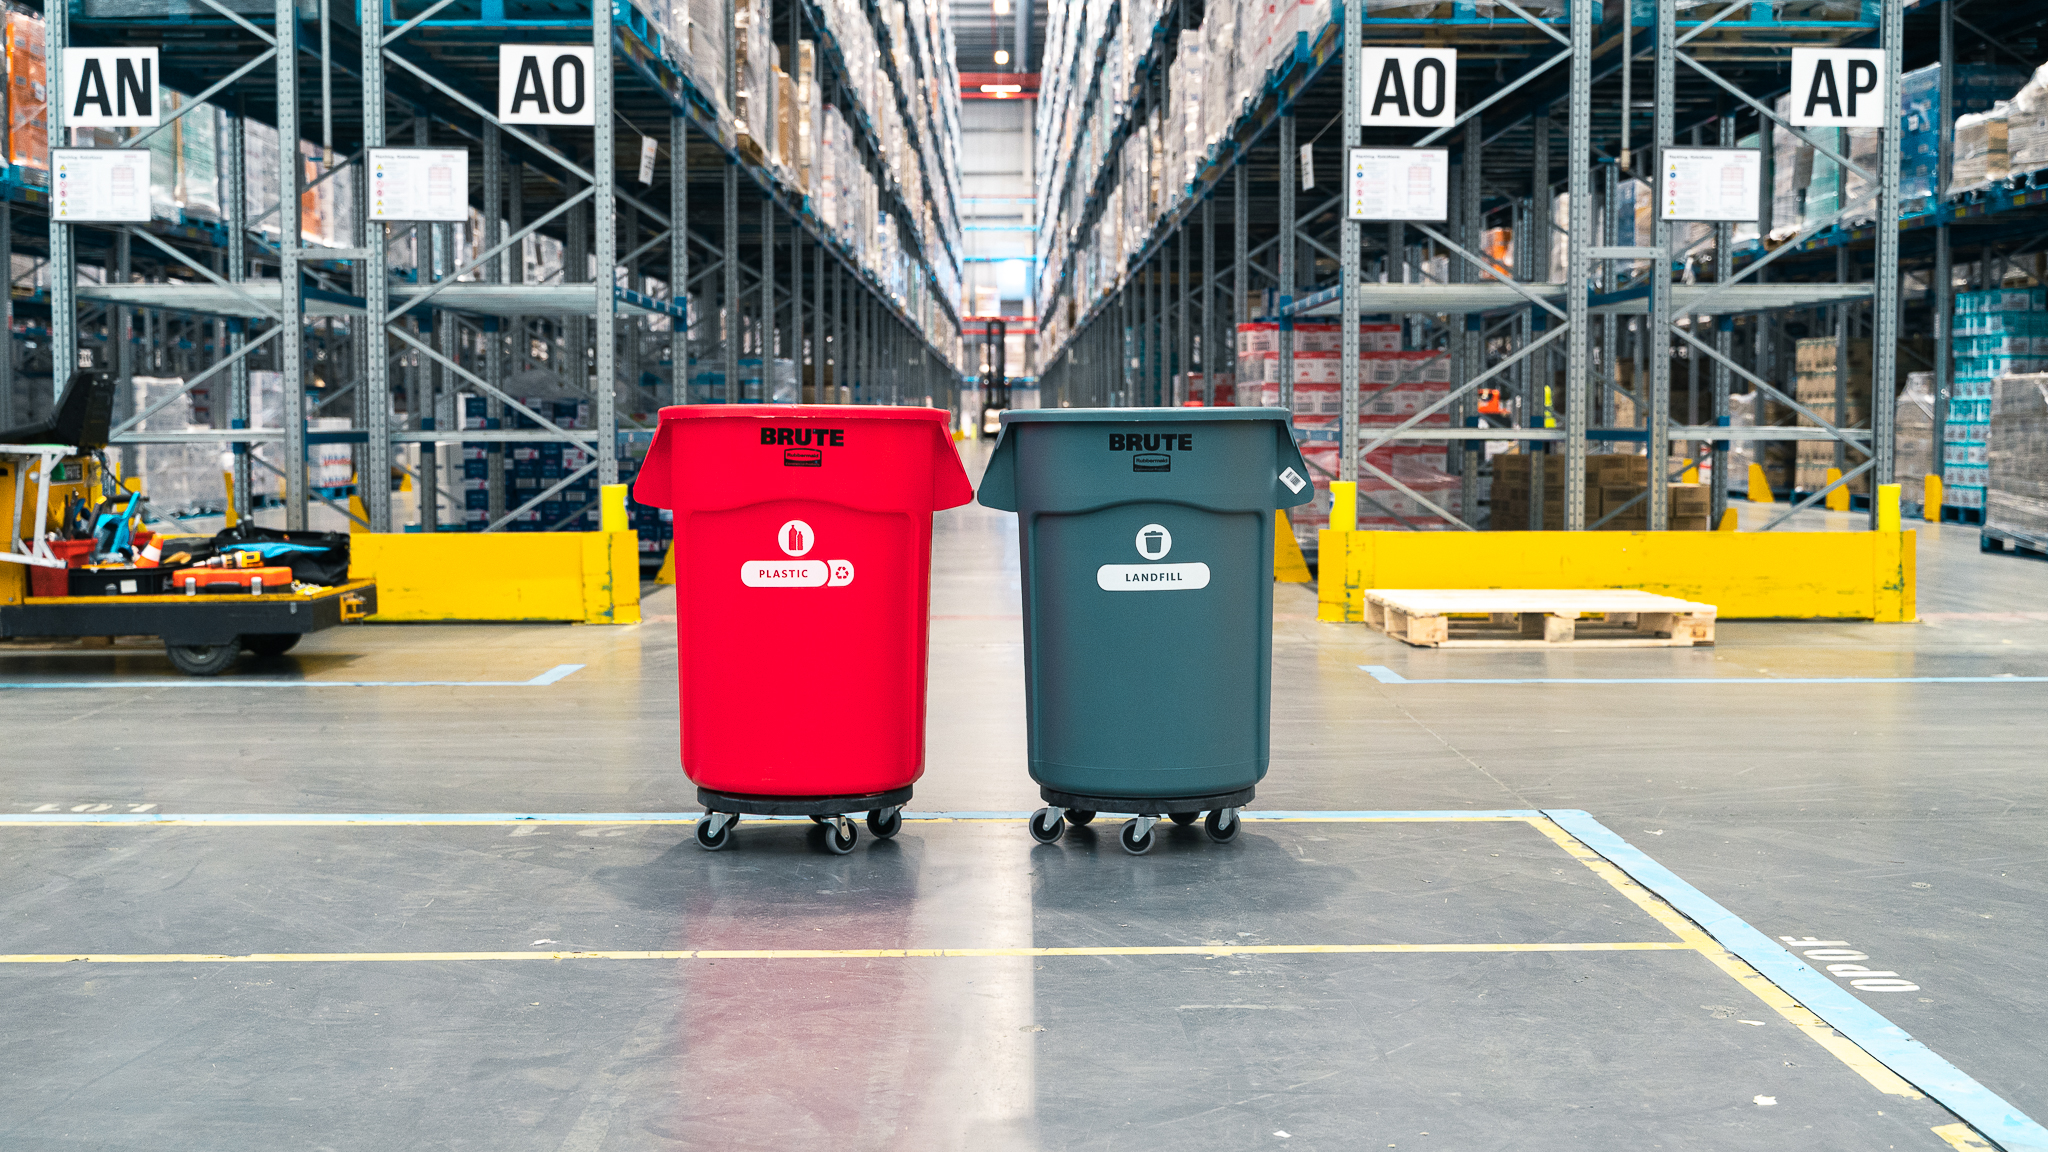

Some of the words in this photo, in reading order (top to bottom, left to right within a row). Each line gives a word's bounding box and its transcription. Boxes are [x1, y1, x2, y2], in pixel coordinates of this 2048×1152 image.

[73, 58, 152, 117] AN
[511, 54, 585, 115] AO
[1370, 57, 1446, 118] AO
[1804, 59, 1878, 117] AP
[761, 427, 844, 447] BRUTE
[1109, 433, 1192, 451] BRUTE
[759, 569, 808, 578] PLASTIC
[1125, 572, 1183, 582] LANDFILL
